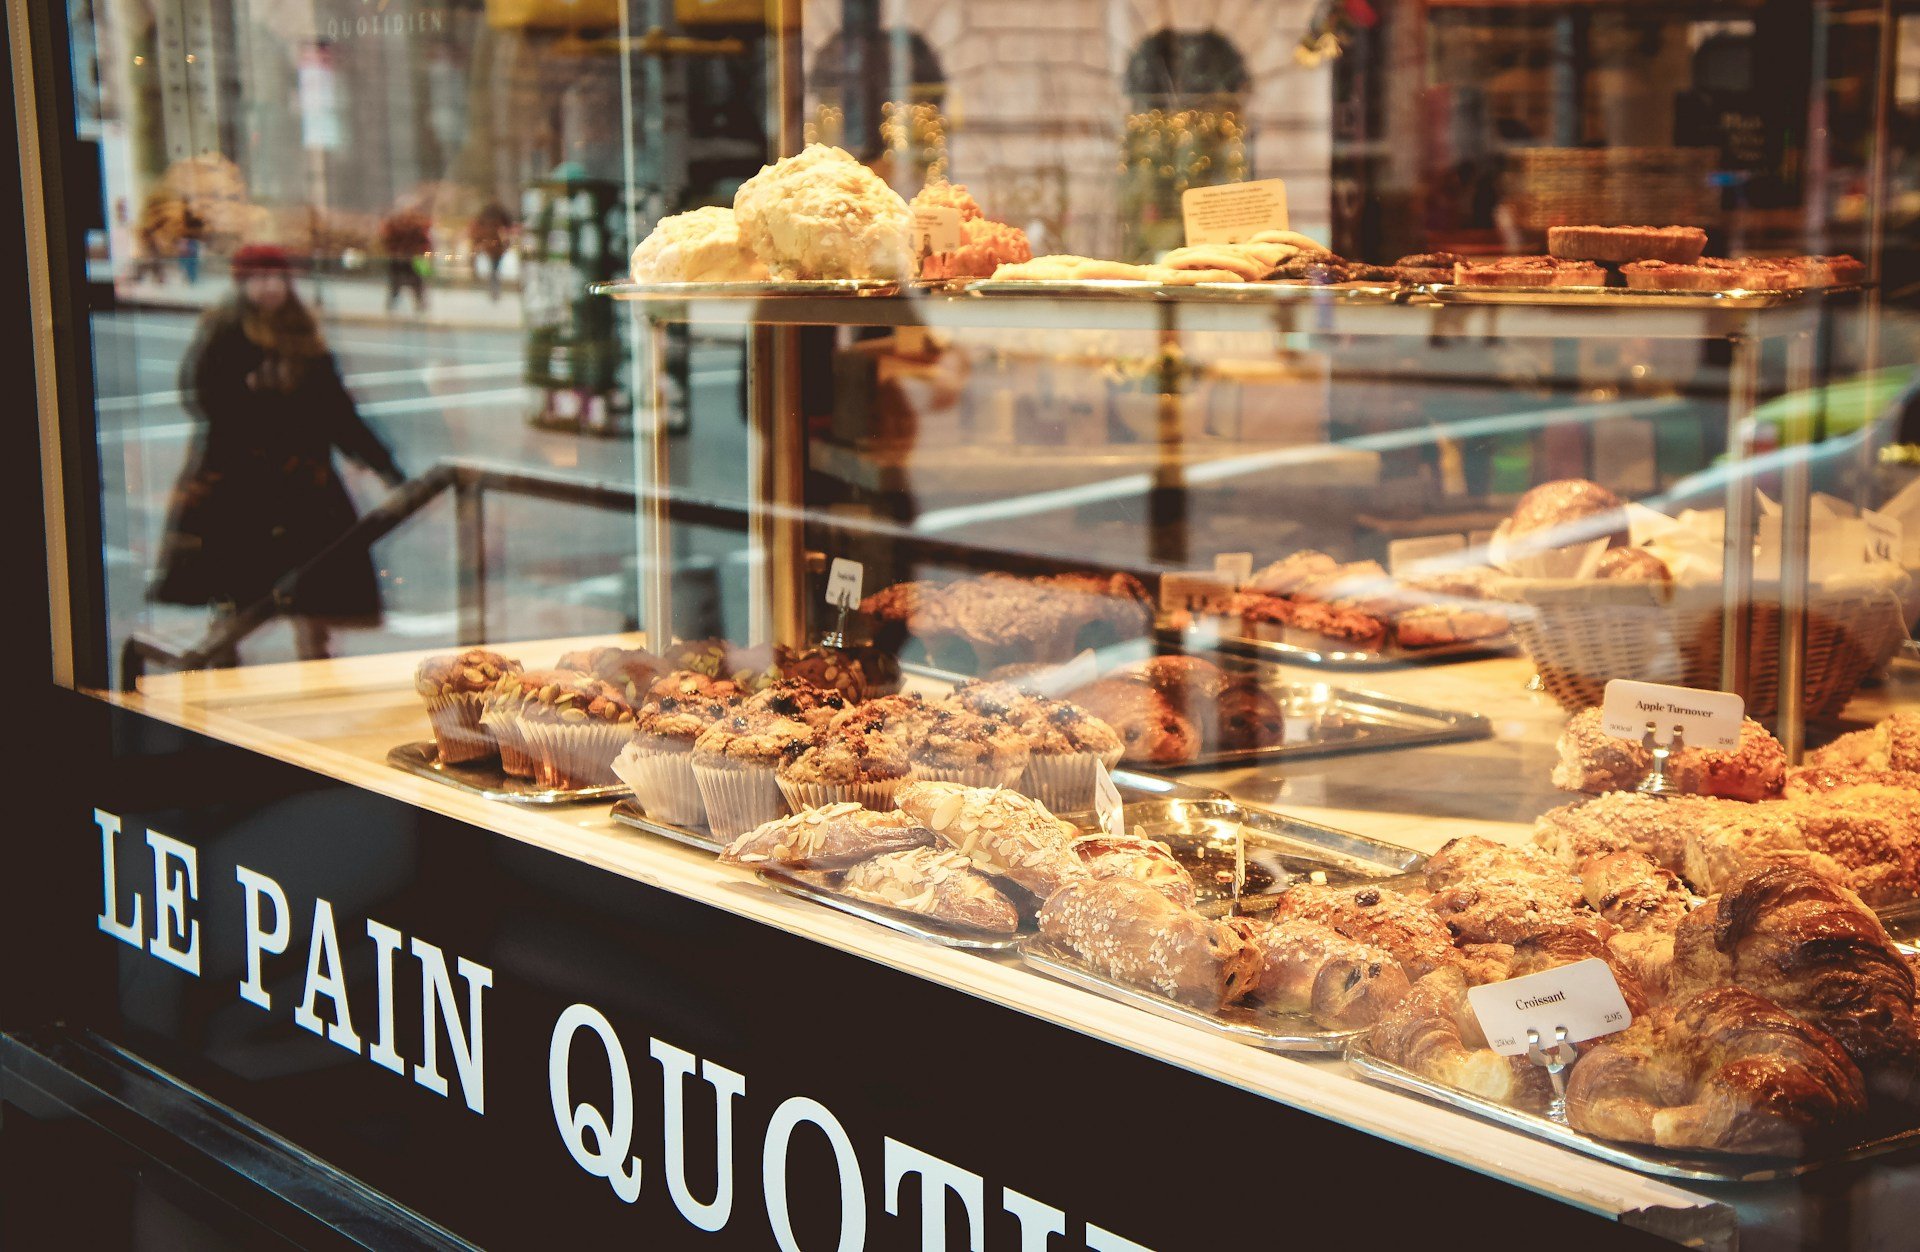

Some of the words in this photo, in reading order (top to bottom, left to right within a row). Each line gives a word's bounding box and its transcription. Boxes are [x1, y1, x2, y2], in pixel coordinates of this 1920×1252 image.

[1635, 700, 1665, 713] Apple
[1666, 703, 1714, 719] Turnover
[95, 808, 201, 977] LE
[236, 865, 493, 1116] PAIN
[1515, 990, 1567, 1011] Croissant
[1604, 1011, 1623, 1023] 2.95
